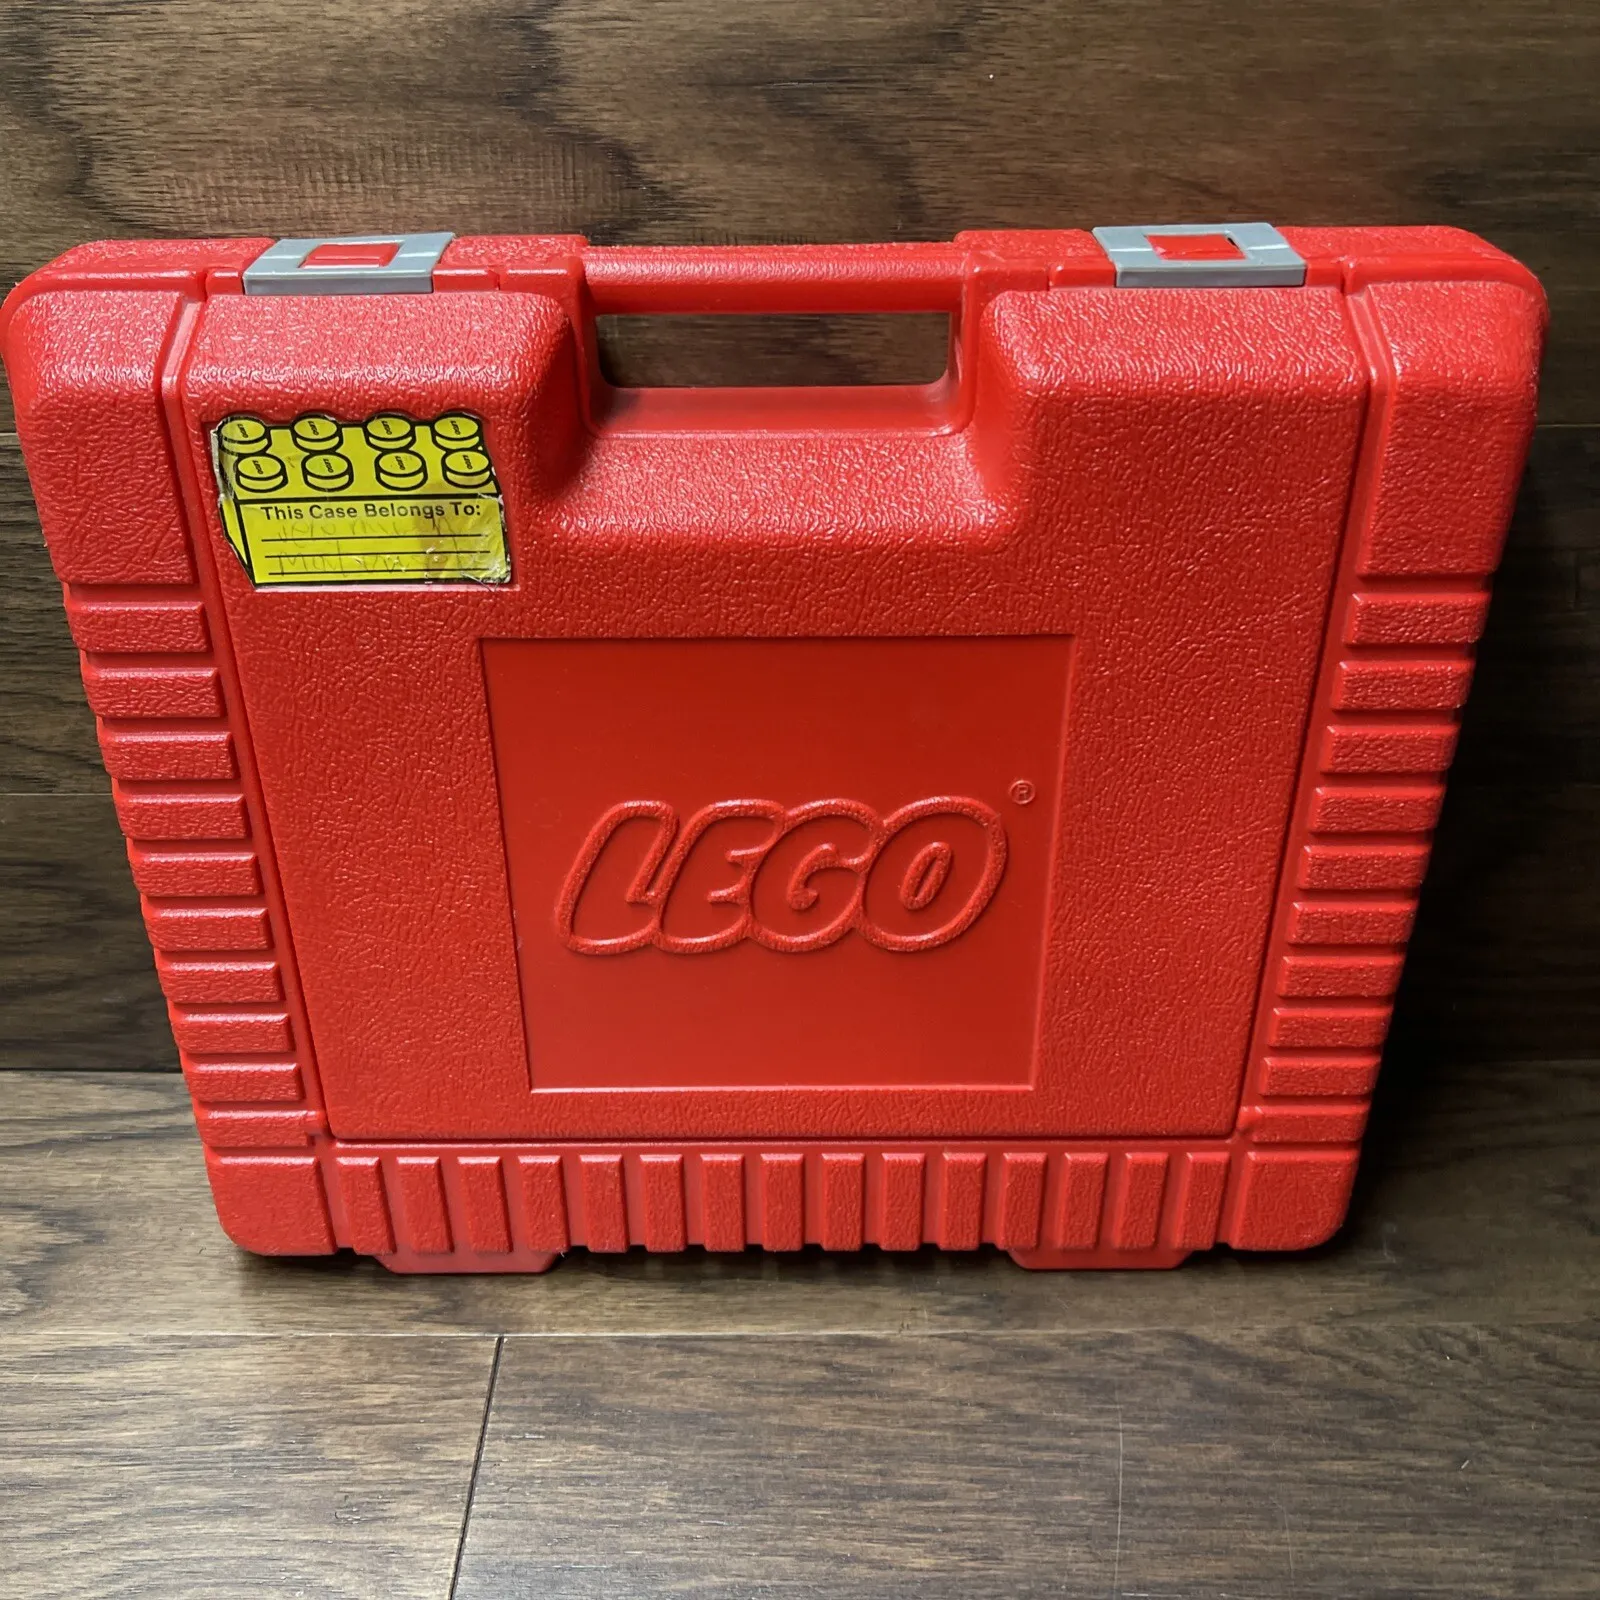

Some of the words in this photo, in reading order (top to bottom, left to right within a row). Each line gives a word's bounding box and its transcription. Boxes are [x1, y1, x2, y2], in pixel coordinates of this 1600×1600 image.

[261, 505, 303, 520] This
[309, 504, 357, 519] Case
[364, 502, 444, 519] Belongs
[452, 501, 479, 516] To:
[555, 796, 1007, 955] LEGO
